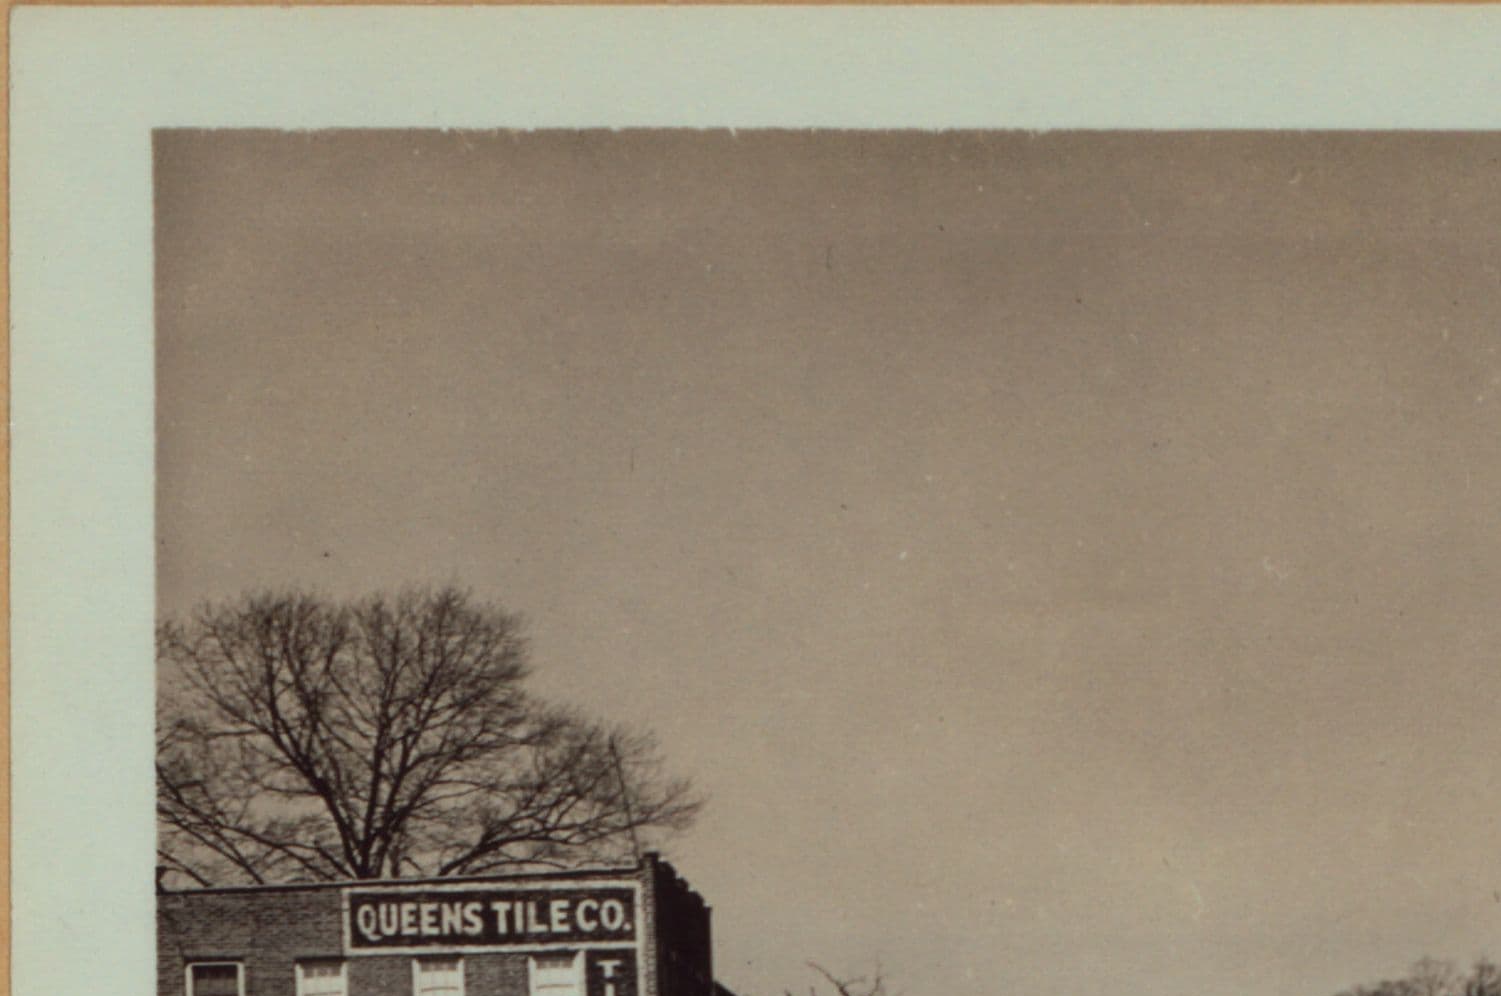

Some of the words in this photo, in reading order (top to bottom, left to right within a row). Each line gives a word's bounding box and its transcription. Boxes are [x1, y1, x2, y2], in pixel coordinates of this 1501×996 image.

[357, 901, 484, 941] QUEENS
[490, 900, 571, 934] TILE
[575, 898, 632, 932] CO.
